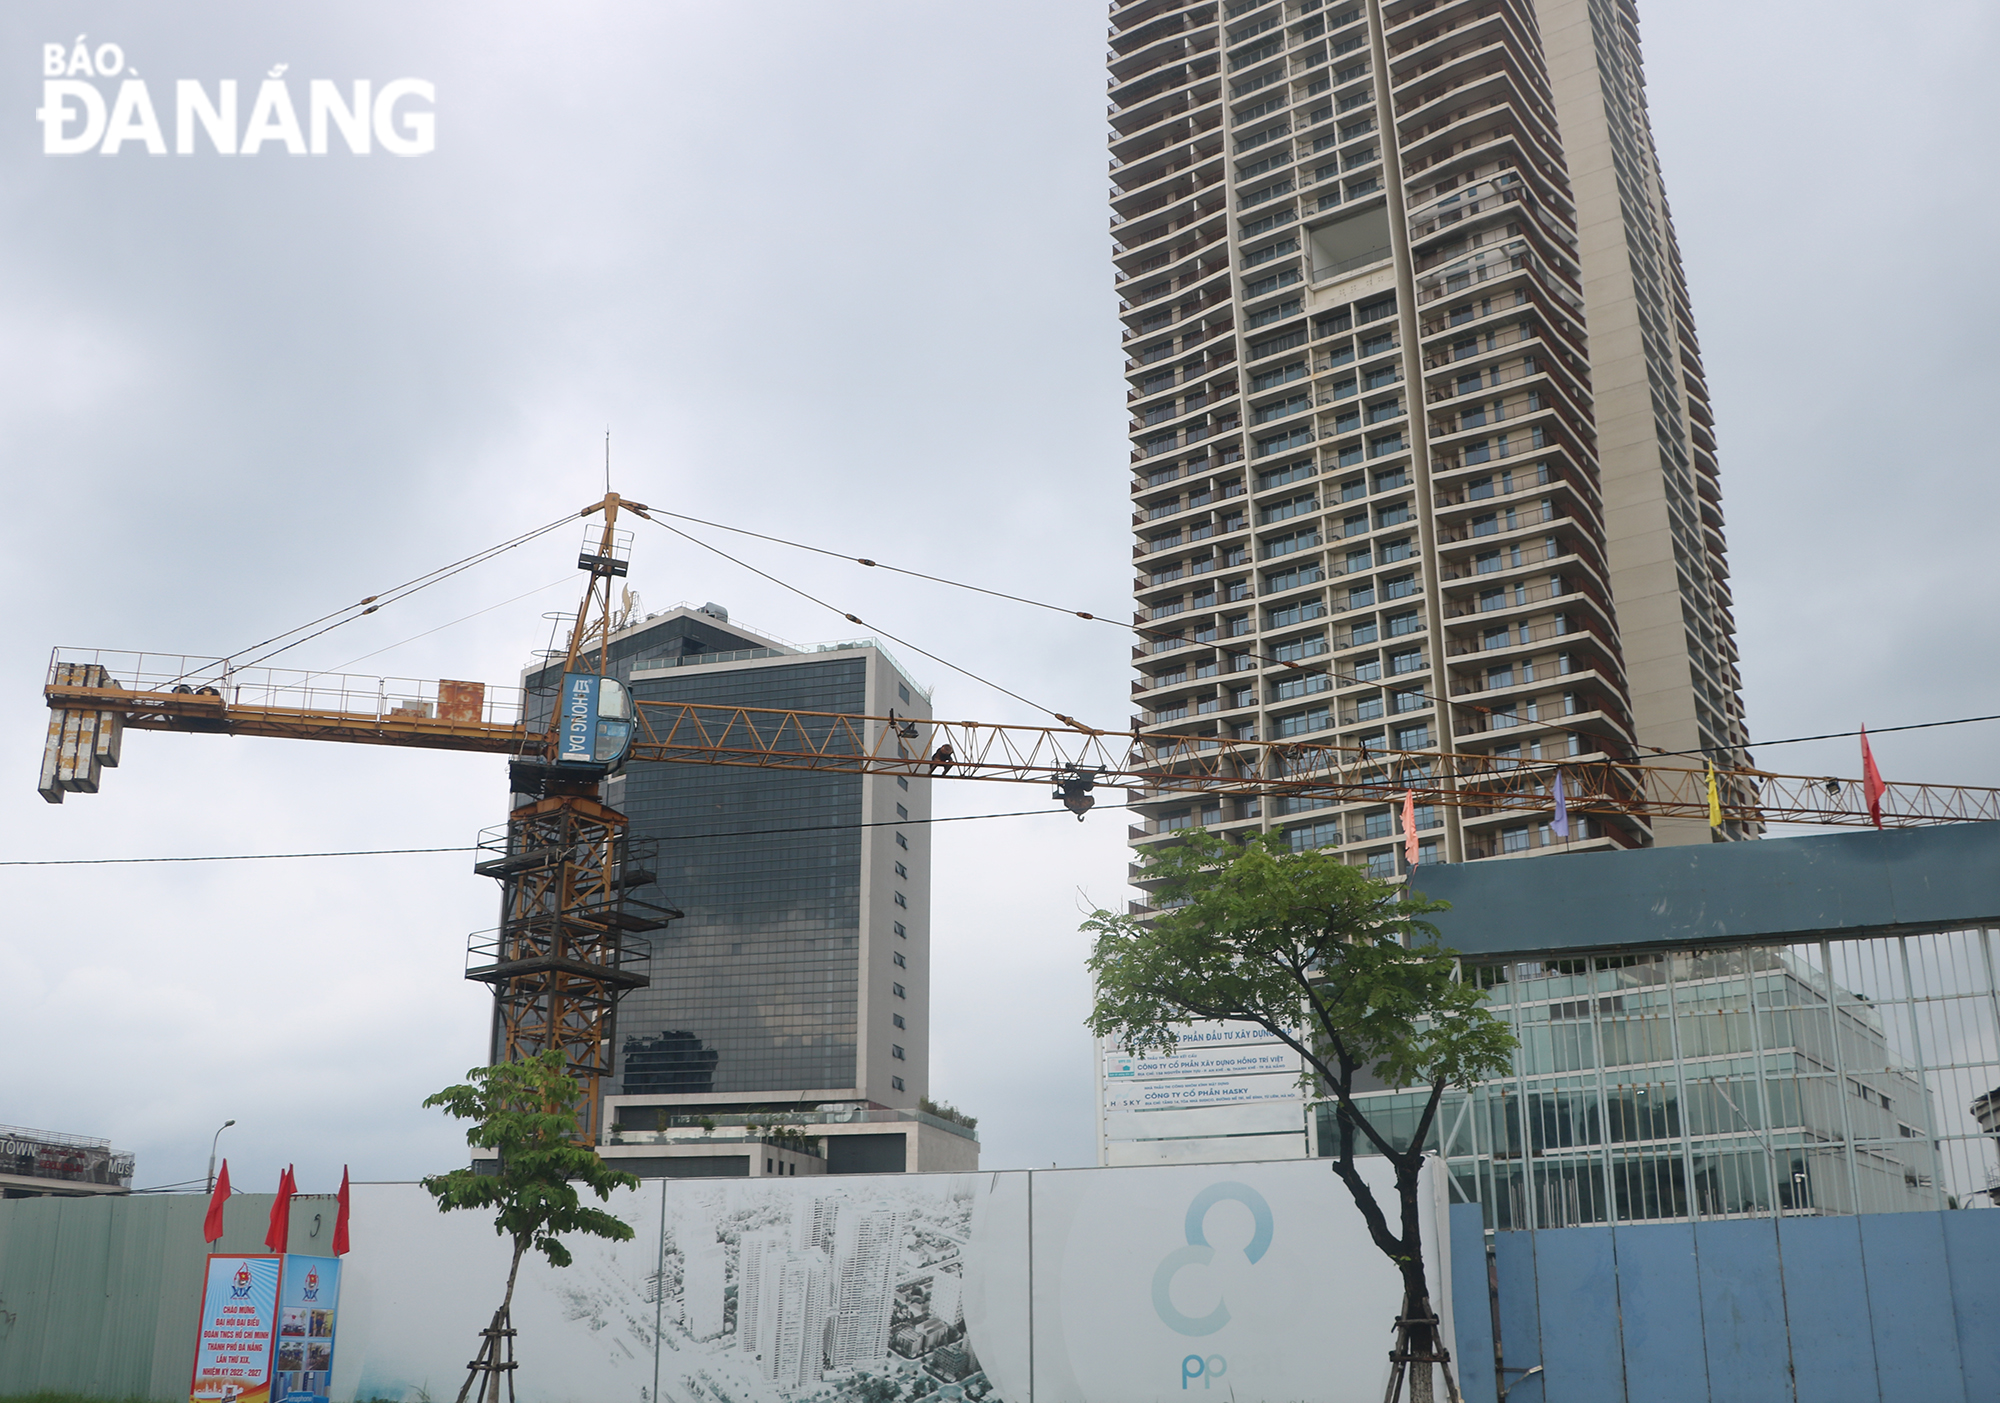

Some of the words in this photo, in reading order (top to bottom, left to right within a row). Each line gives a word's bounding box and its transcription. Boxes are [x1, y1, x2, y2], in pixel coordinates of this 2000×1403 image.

[571, 697, 588, 732] HONG
[568, 735, 586, 752] DA
[1183, 1030, 1204, 1042] PHẦN
[1206, 1029, 1222, 1041] ĐẦU
[1224, 1031, 1233, 1040] TƯ
[1235, 1029, 1251, 1039] XÂY
[1137, 1062, 1158, 1070] CÔNG
[1168, 1060, 1179, 1068] CỔ
[1181, 1059, 1199, 1067] PHẦN
[1270, 1055, 1284, 1063] VIỆT
[1144, 1092, 1170, 1100] CÔNG
[1182, 1088, 1196, 1097] CỔ
[1198, 1087, 1220, 1097] PHẦN
[1222, 1087, 1248, 1095] HASKY
[0, 1140, 36, 1157] TOWN
[223, 1304, 238, 1314] CHÀO
[239, 1304, 255, 1314] MỪNG
[215, 1318, 225, 1327] ĐẠI
[226, 1317, 235, 1327] HỘI
[236, 1318, 246, 1328] ĐẠI
[247, 1316, 260, 1327] BIỂU
[203, 1330, 219, 1338] ĐOÀN
[220, 1330, 234, 1338] TNCS
[234, 1328, 243, 1338] HỒ
[243, 1329, 253, 1339] CHÍ
[254, 1331, 269, 1339] MINH
[207, 1341, 225, 1351] THÀNH
[226, 1341, 238, 1351] PHỐ
[238, 1342, 246, 1351] ĐÀ
[247, 1341, 263, 1351] NẴNG
[215, 1353, 227, 1363] LẦN
[228, 1354, 239, 1364] THỨ
[239, 1356, 250, 1365] XIX,
[202, 1367, 220, 1378] NHIỆM
[221, 1367, 229, 1376] KỲ
[229, 1368, 244, 1376] 2022
[247, 1369, 262, 1377] 2027
[288, 1395, 313, 1403] vinaphone
